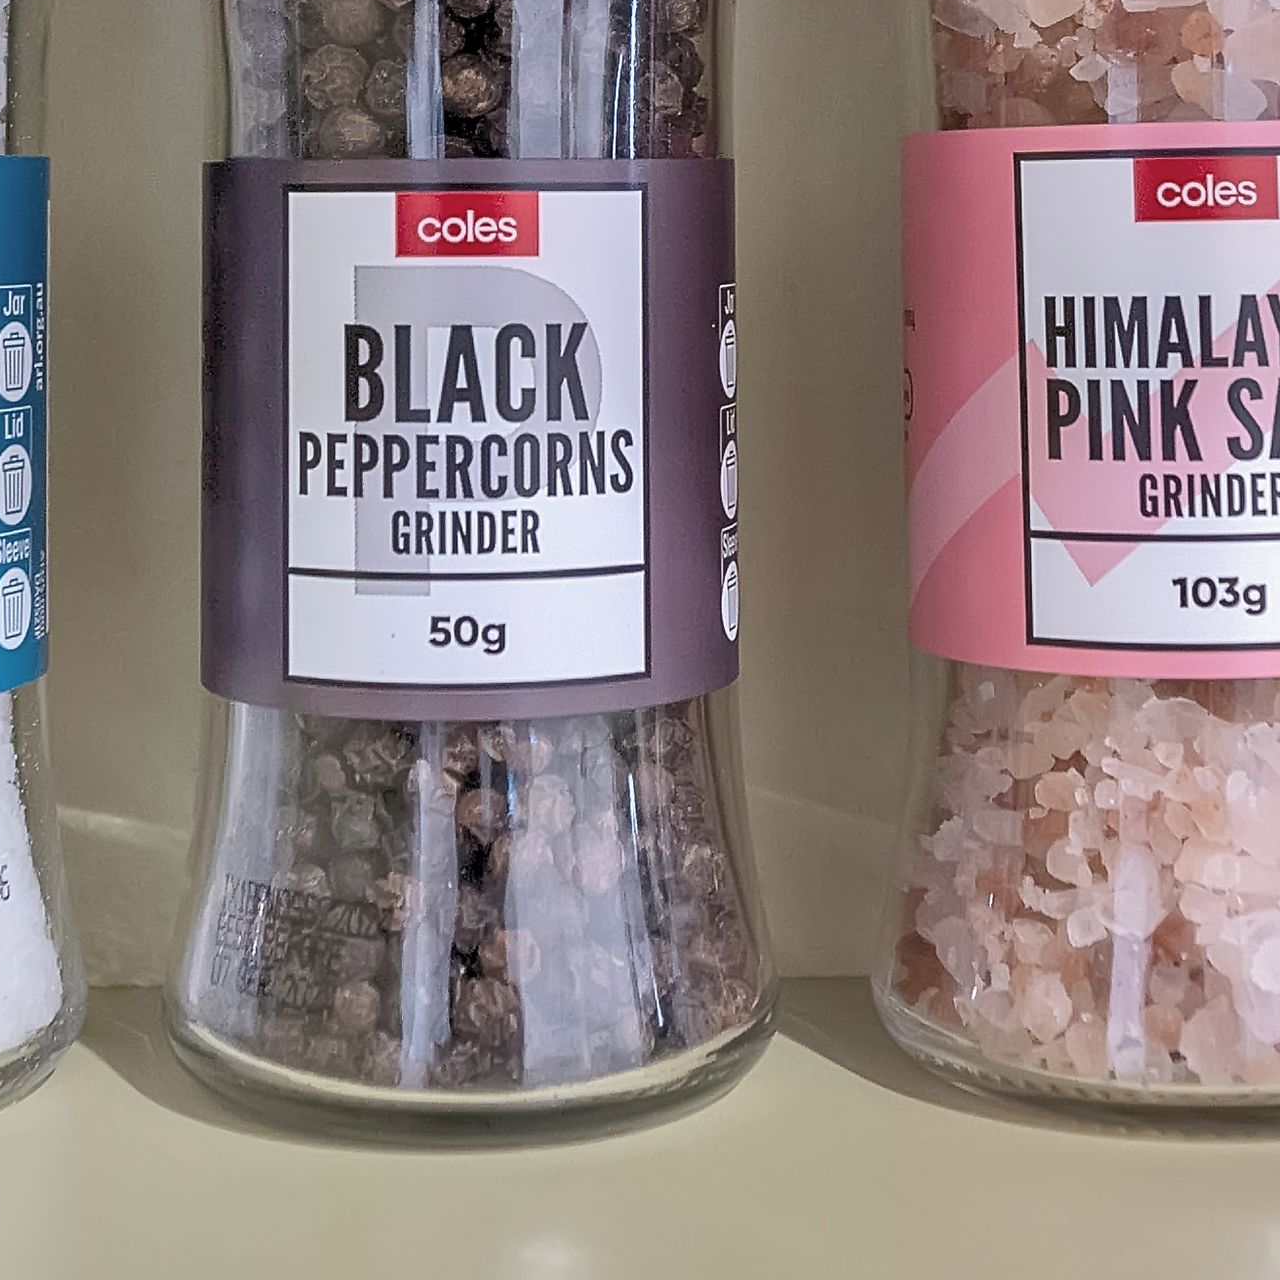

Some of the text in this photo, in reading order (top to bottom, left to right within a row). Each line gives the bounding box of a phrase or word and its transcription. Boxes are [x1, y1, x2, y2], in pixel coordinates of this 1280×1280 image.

[1156, 174, 1258, 207] coles
[417, 210, 518, 244] coles
[3, 291, 25, 316] Jar
[343, 321, 590, 424] BLACK
[4, 412, 24, 439] Lid
[1046, 377, 1203, 462] PINK
[298, 428, 635, 500] PEPPERCORNS
[391, 508, 541, 556] GRINDER
[1171, 576, 1267, 615] 103g
[428, 615, 508, 655] 50g
